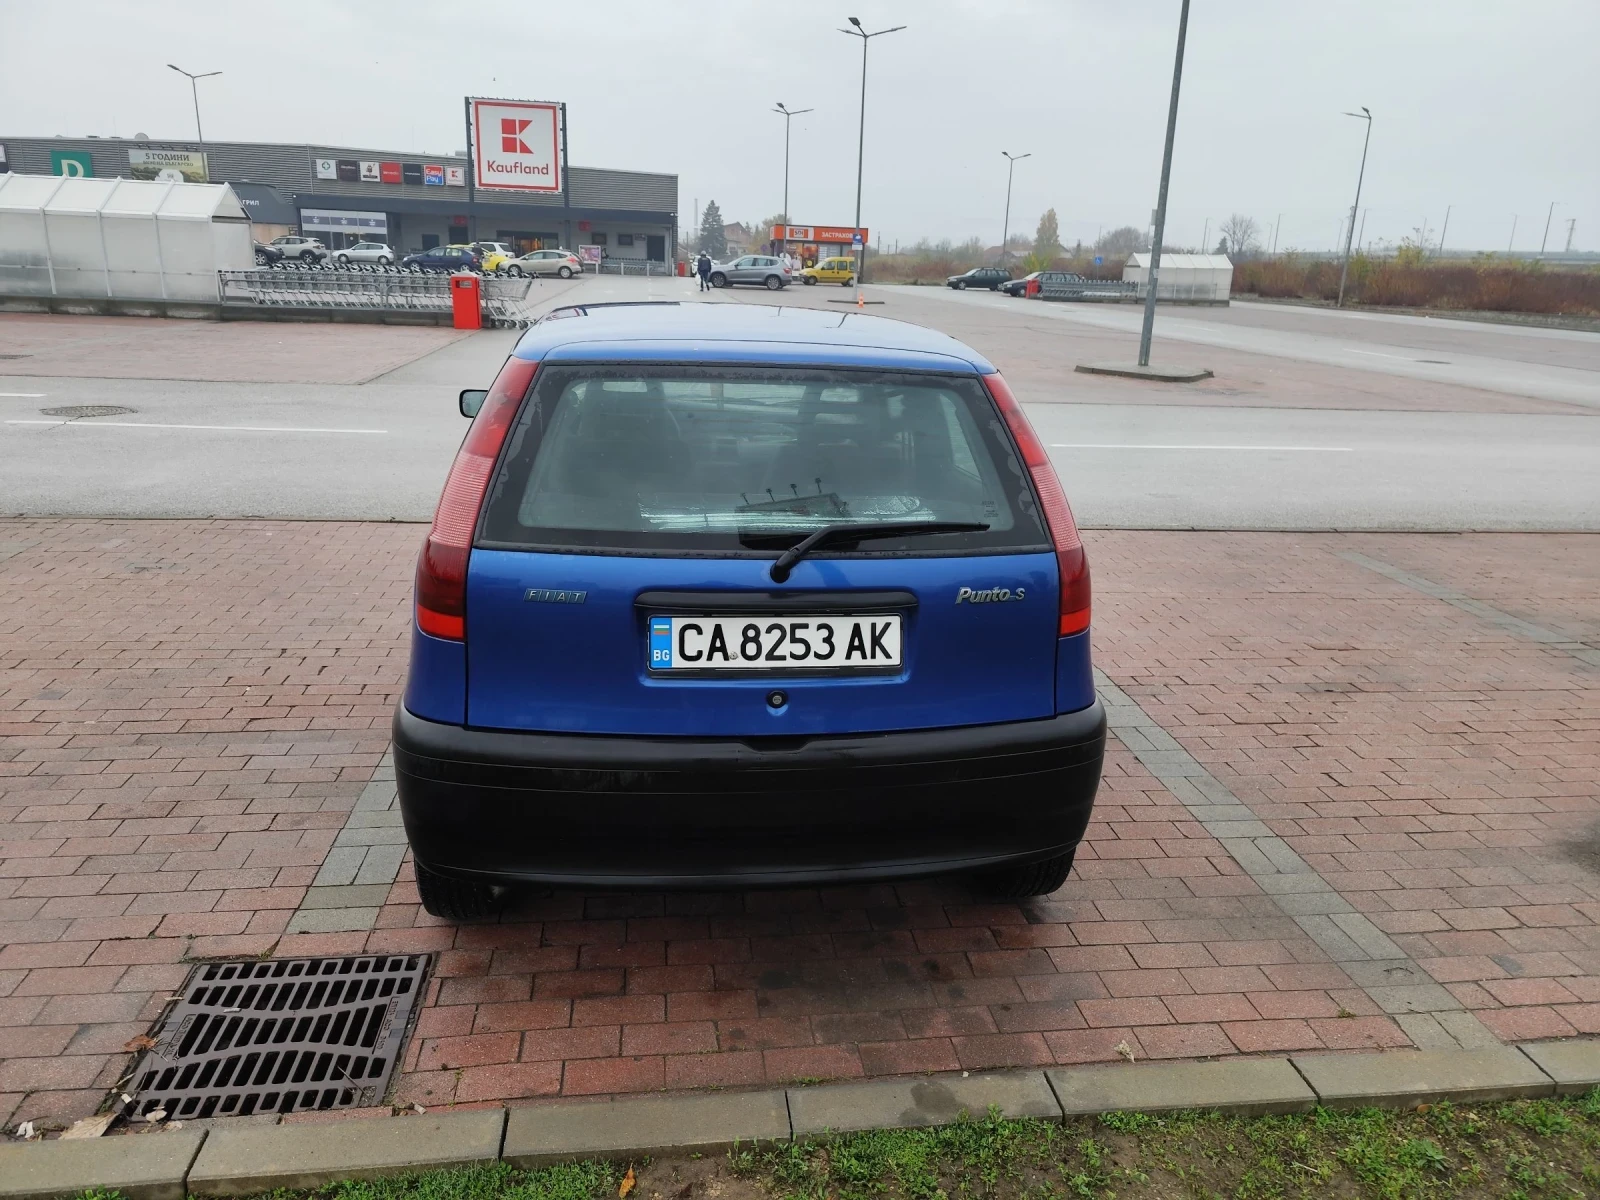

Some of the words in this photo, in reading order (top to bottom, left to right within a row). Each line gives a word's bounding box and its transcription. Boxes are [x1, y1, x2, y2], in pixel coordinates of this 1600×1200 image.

[152, 153, 190, 161] ГОДИНИ
[426, 169, 442, 177] Easy
[487, 160, 549, 175] Kaufland
[427, 175, 439, 183] Pay
[821, 231, 853, 239] ЗАСТРАХОВ
[528, 590, 582, 602] FIAT
[954, 586, 1011, 604] Punto
[678, 623, 730, 662] CA
[740, 622, 836, 661] 8253
[845, 621, 893, 660] AK
[653, 650, 670, 661] BG
